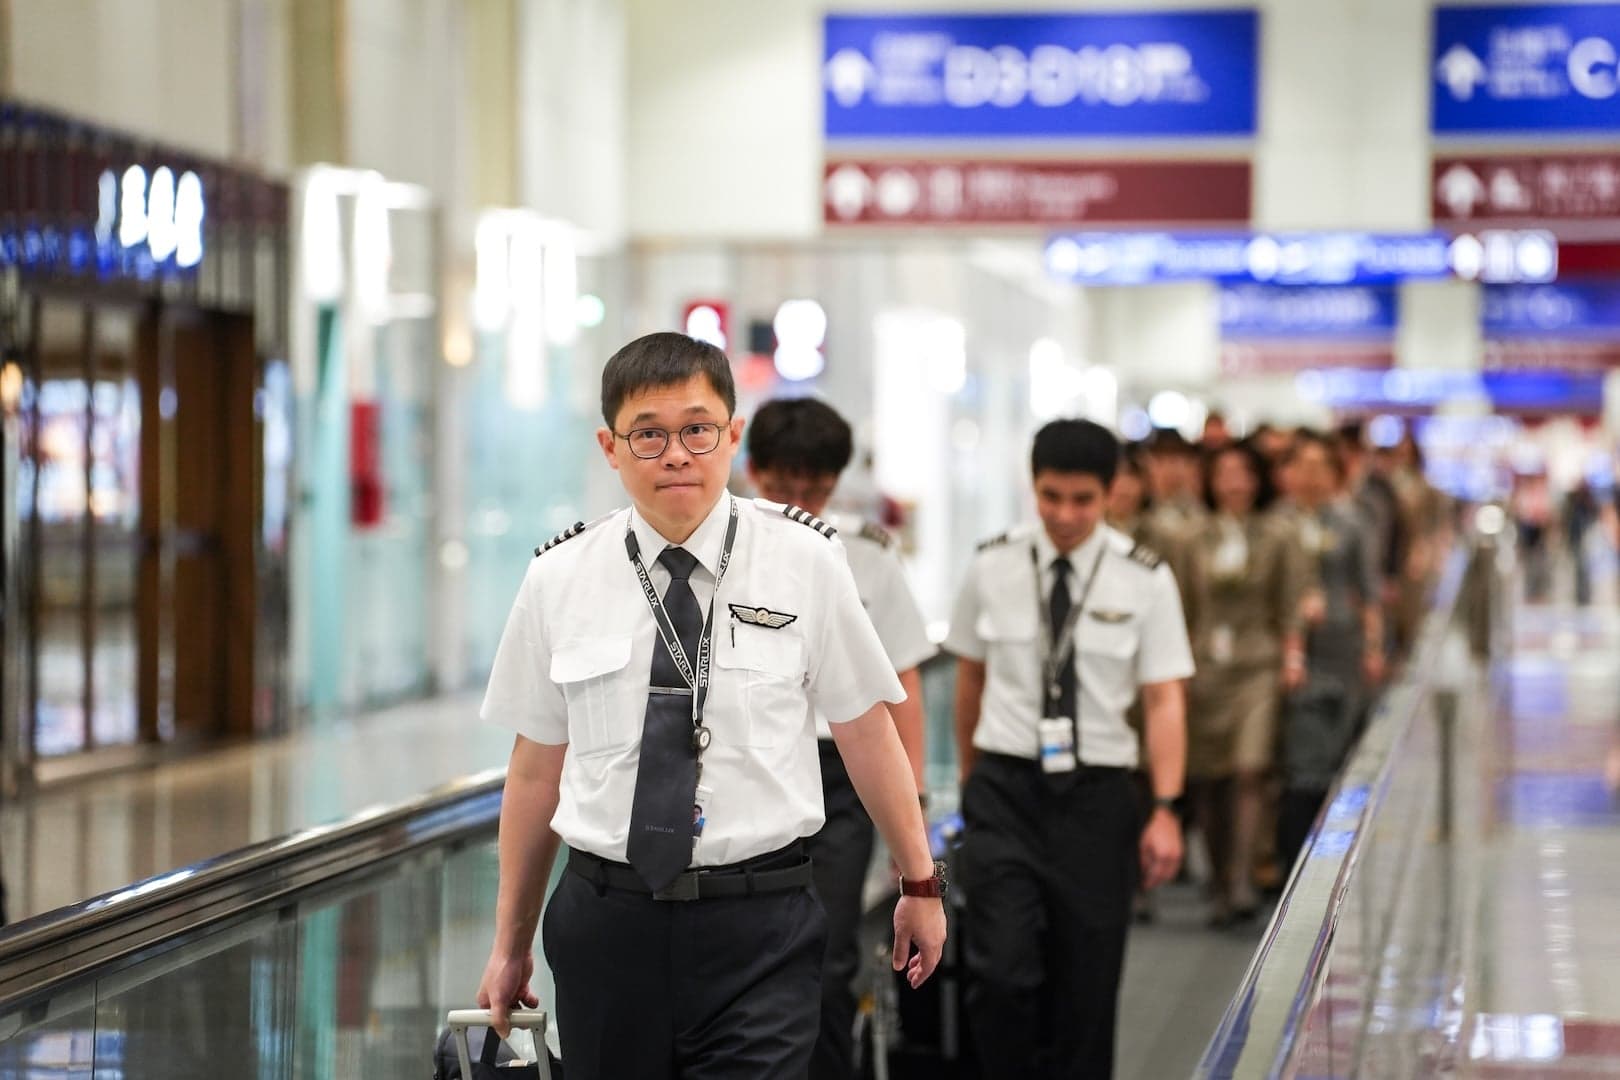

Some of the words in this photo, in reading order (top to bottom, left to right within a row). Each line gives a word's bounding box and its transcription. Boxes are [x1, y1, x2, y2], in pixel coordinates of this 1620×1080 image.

[1567, 37, 1620, 99] C
[635, 562, 659, 608] STARLUX
[700, 637, 711, 688] STARLUX
